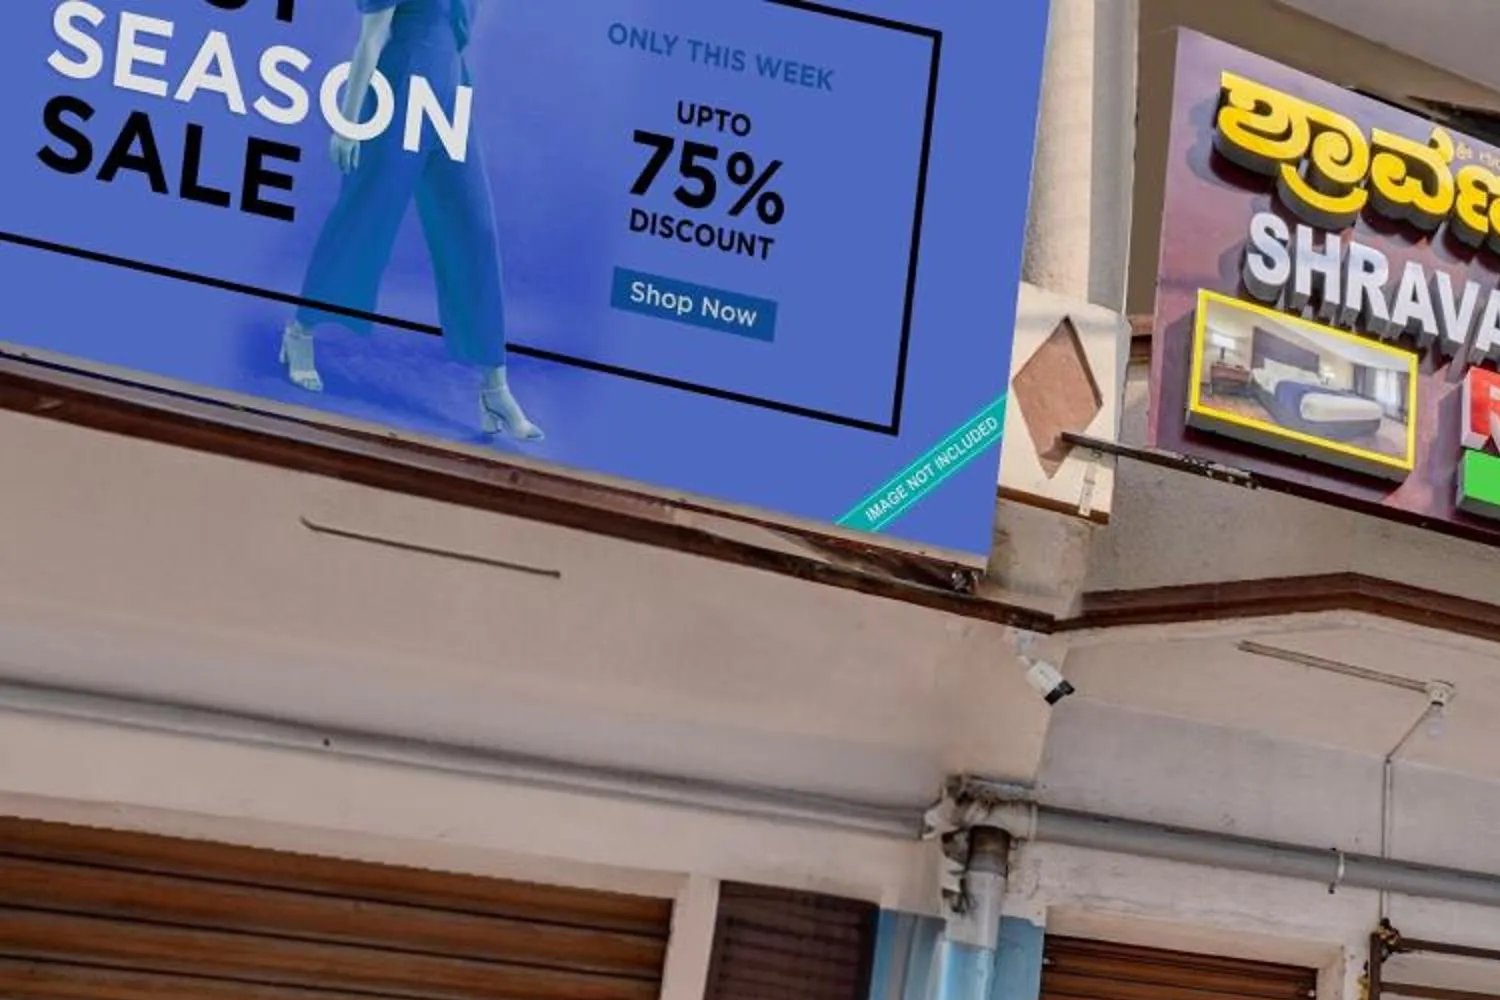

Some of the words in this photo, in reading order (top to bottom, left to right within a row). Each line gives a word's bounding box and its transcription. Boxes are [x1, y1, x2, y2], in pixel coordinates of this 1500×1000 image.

[47, 0, 472, 163] SEASON
[607, 23, 679, 57] ONLY
[688, 39, 746, 73] THIS
[756, 57, 835, 91] WEEK
[37, 95, 301, 222] SALE
[677, 100, 751, 137] UPTO
[629, 130, 785, 225] 75%
[629, 208, 775, 260] DISCOUNT
[630, 281, 693, 315] Shop
[701, 297, 757, 328] Now
[865, 485, 908, 522] IMAGE
[906, 463, 936, 491] NOT
[934, 417, 998, 470] INCLUDED
